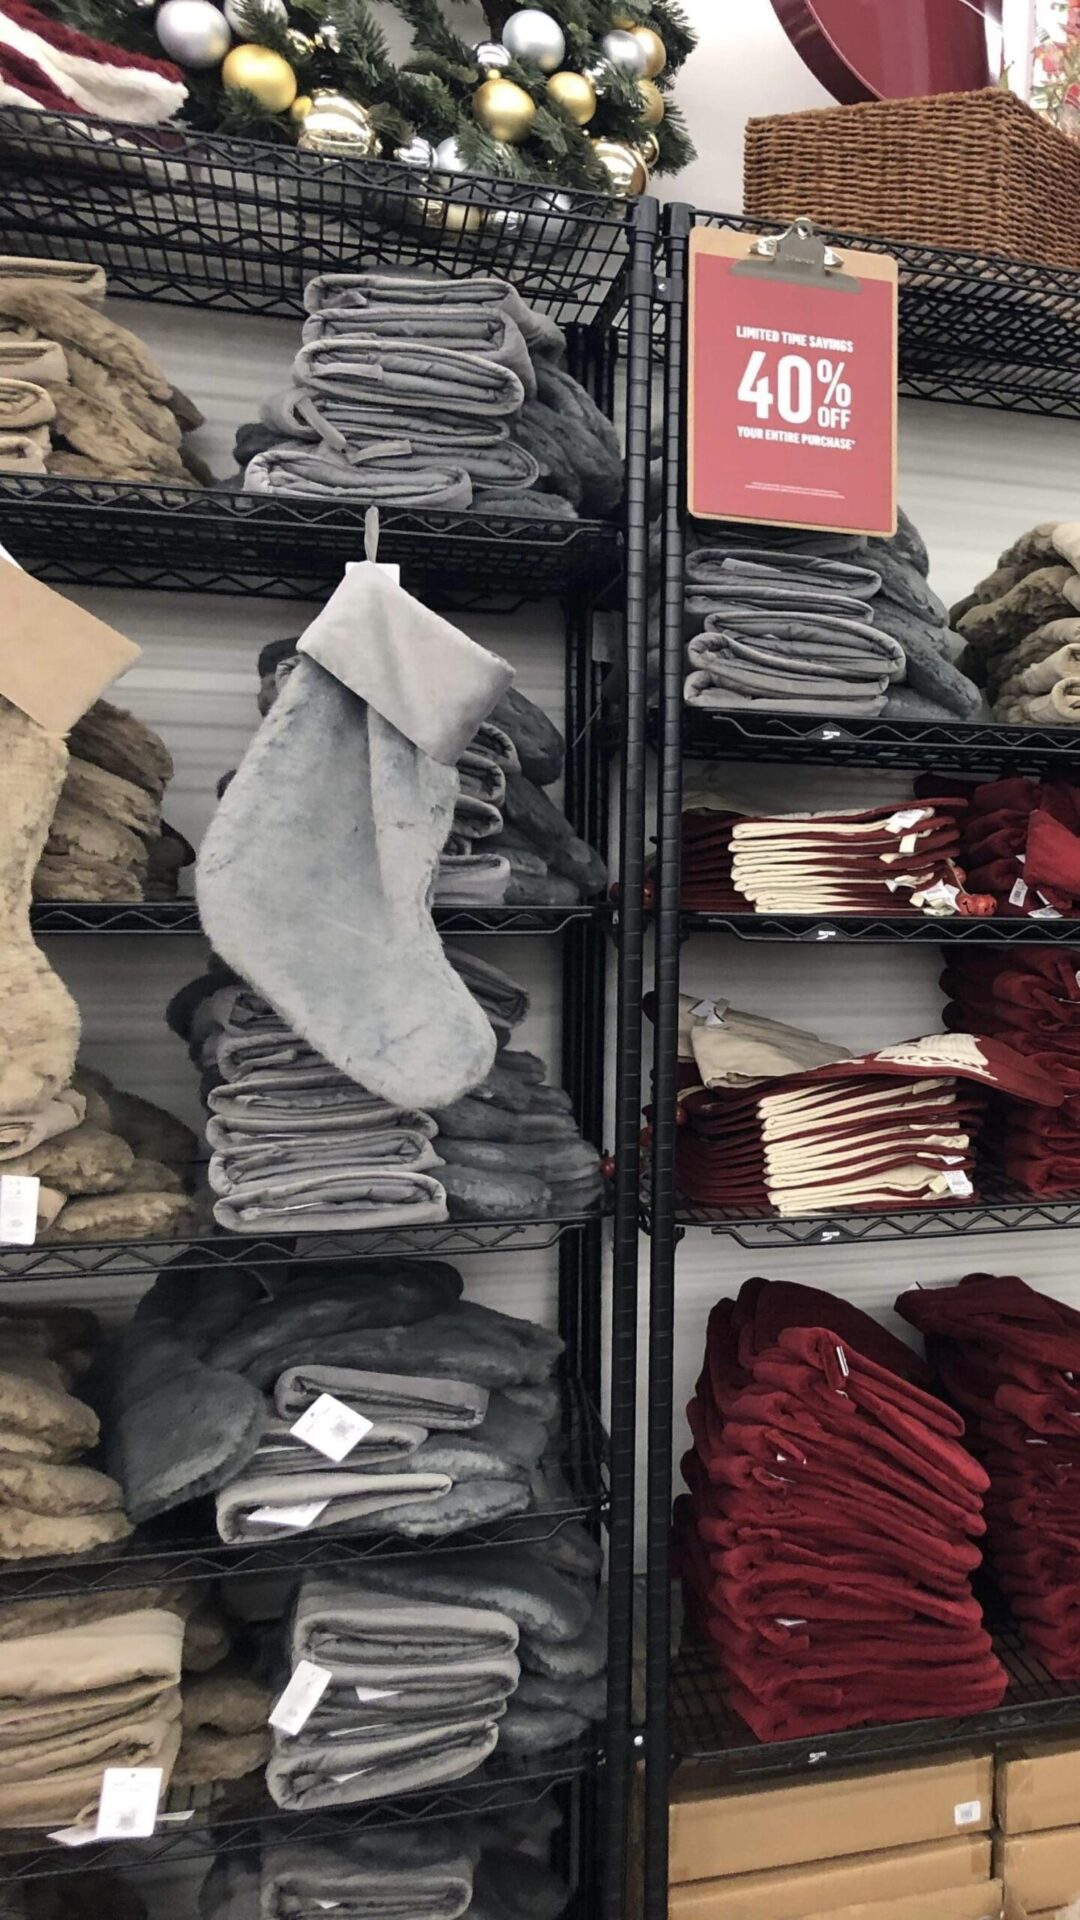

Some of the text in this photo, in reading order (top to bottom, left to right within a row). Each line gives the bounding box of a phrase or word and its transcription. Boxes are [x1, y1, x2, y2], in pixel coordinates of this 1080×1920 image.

[736, 325, 854, 353] LIMITED TIME SAVINGS
[817, 406, 851, 430] OFF
[737, 425, 764, 440] YOUR
[765, 429, 801, 444] ENTIRE
